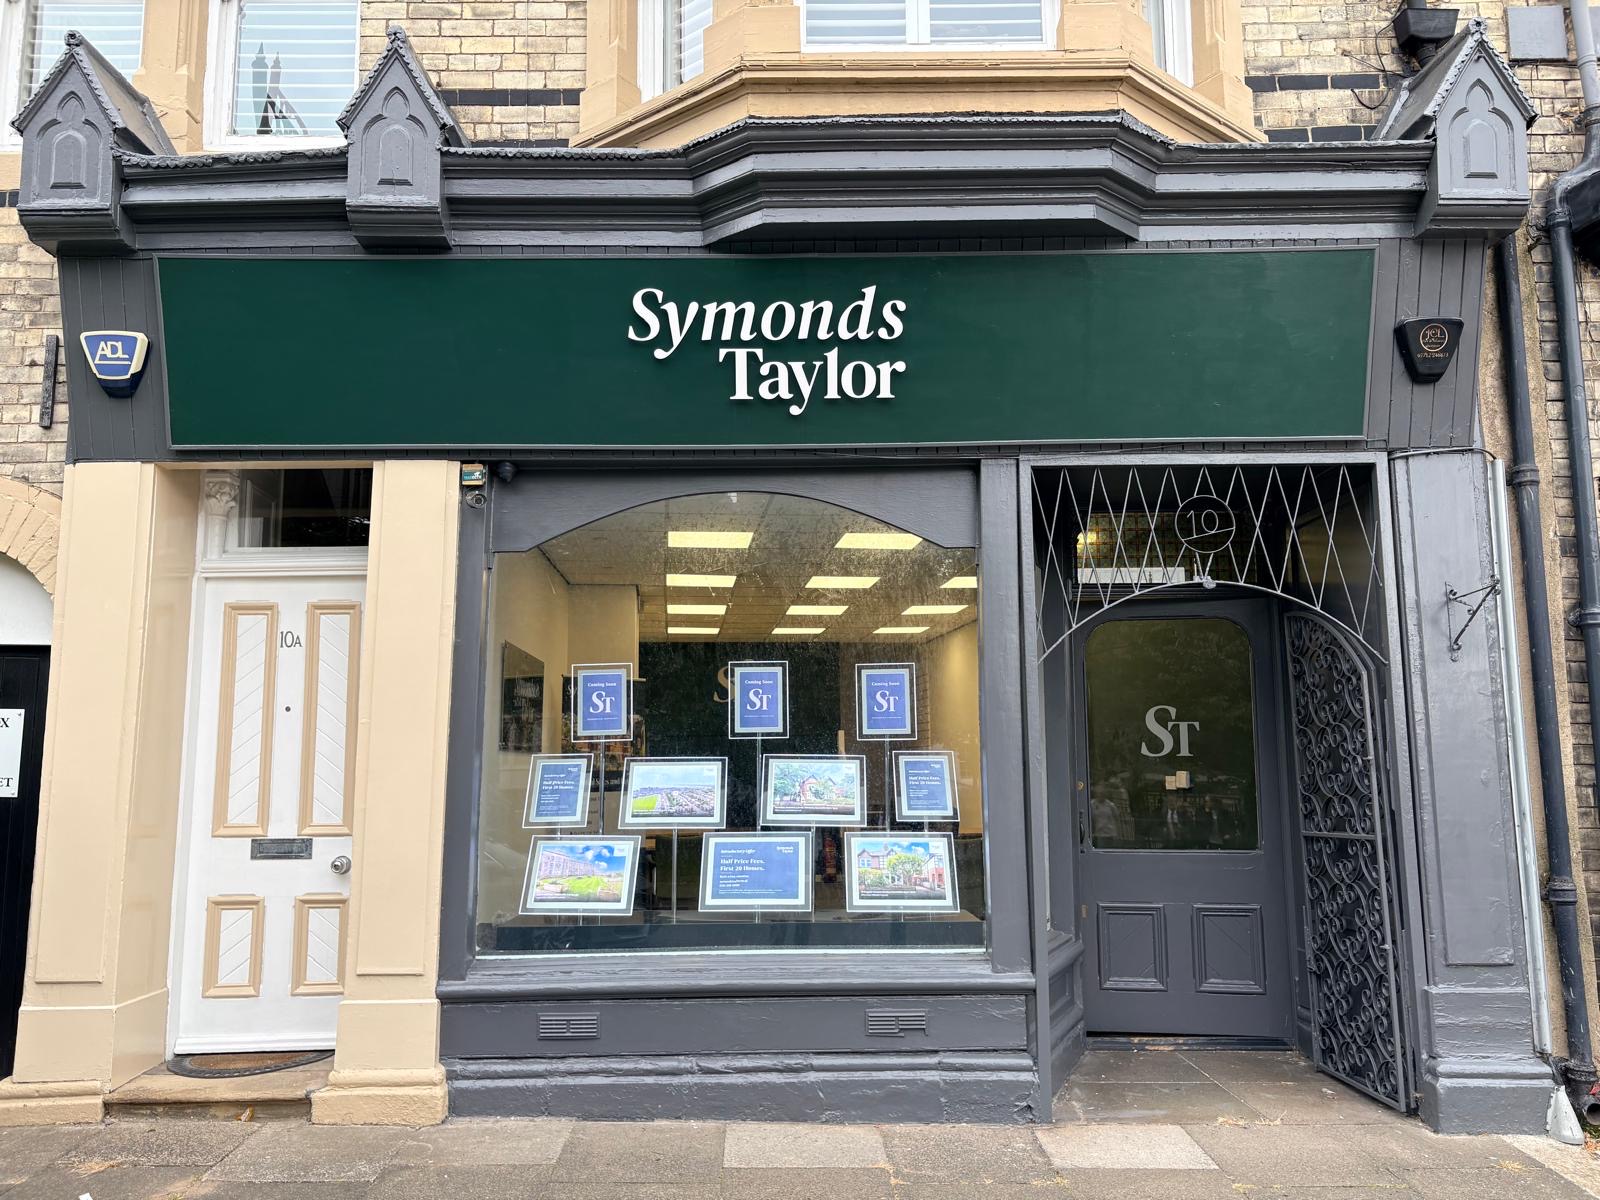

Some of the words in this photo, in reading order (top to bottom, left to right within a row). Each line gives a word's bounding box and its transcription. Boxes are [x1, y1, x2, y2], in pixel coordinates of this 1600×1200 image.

[628, 285, 907, 360] Symonds
[94, 341, 130, 361] ADL
[718, 347, 907, 416] Taylor
[1187, 509, 1219, 537] 10
[280, 630, 303, 648] 10A
[590, 690, 615, 714] ST
[746, 688, 772, 711] ST
[874, 689, 899, 713] ST
[1140, 704, 1200, 757] ST
